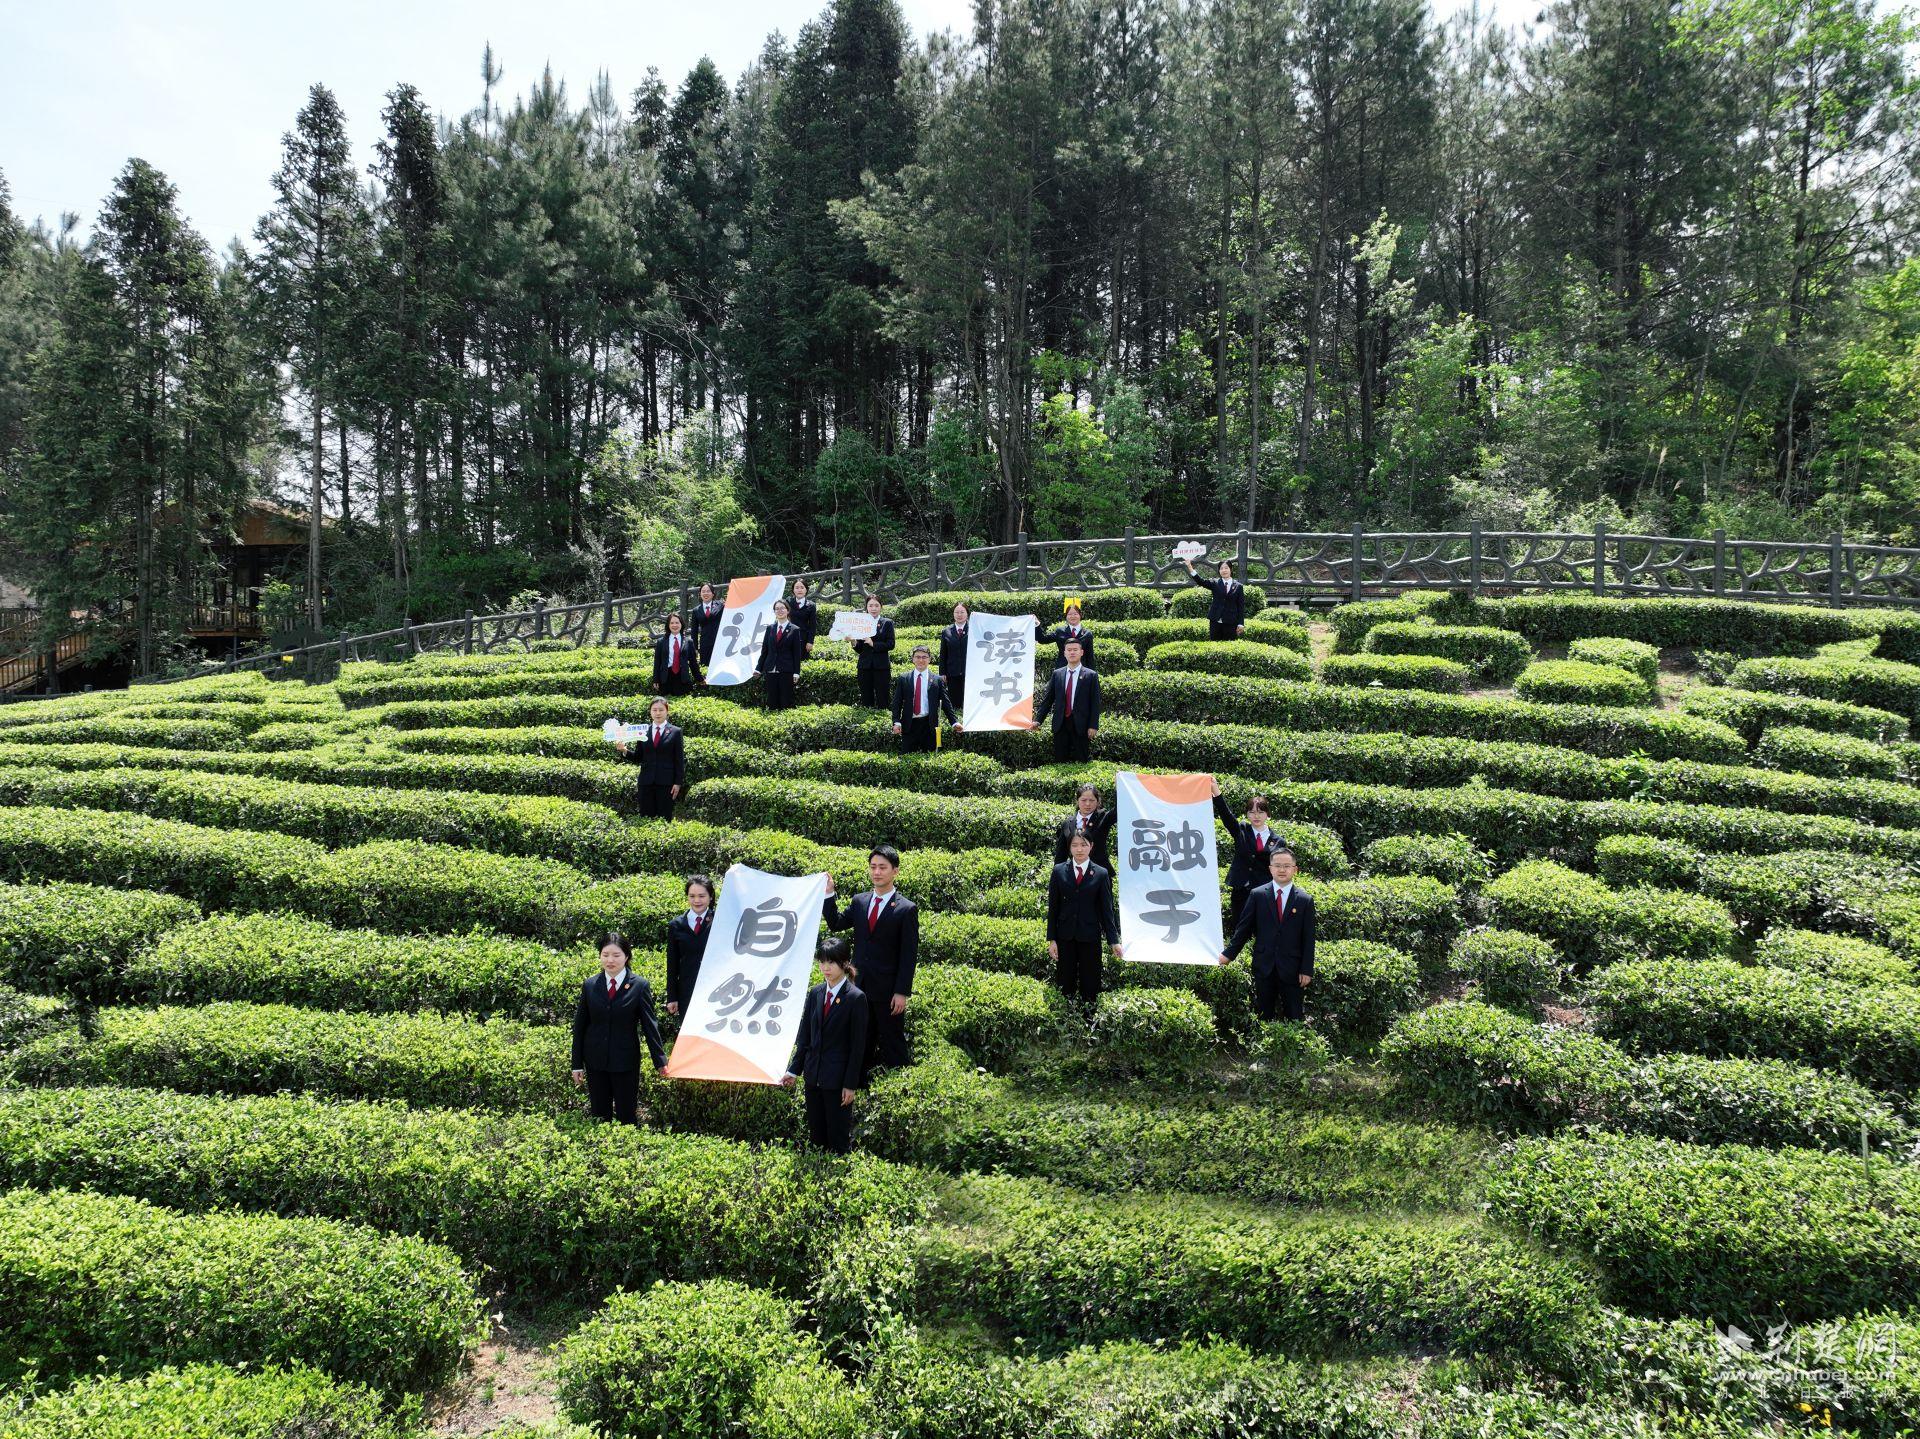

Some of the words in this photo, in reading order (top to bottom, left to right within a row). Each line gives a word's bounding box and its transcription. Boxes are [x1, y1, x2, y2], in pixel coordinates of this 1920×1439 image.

[722, 612, 769, 657] 让
[976, 628, 1027, 706] 读书
[1129, 819, 1207, 944] 融于
[705, 897, 799, 1036] 自然
